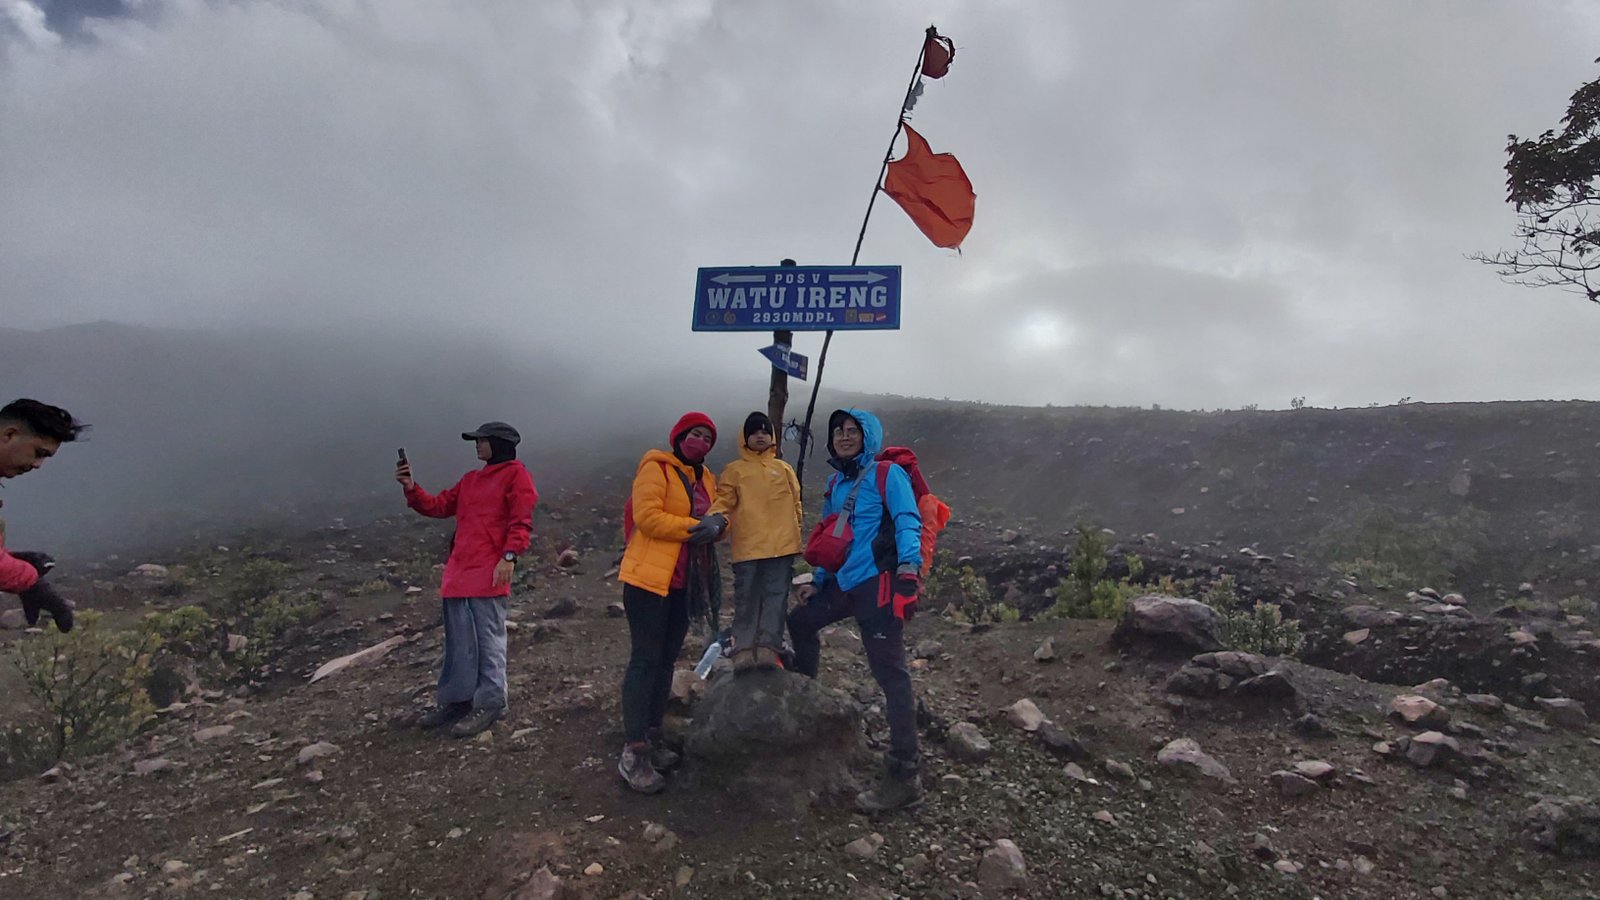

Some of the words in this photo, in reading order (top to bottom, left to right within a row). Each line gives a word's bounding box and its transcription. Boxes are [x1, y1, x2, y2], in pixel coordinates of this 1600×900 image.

[774, 273, 805, 284] POS
[812, 273, 821, 284] V
[707, 287, 786, 309] WATU
[796, 286, 887, 309] IRENG
[753, 312, 835, 323] 2930MDPL
